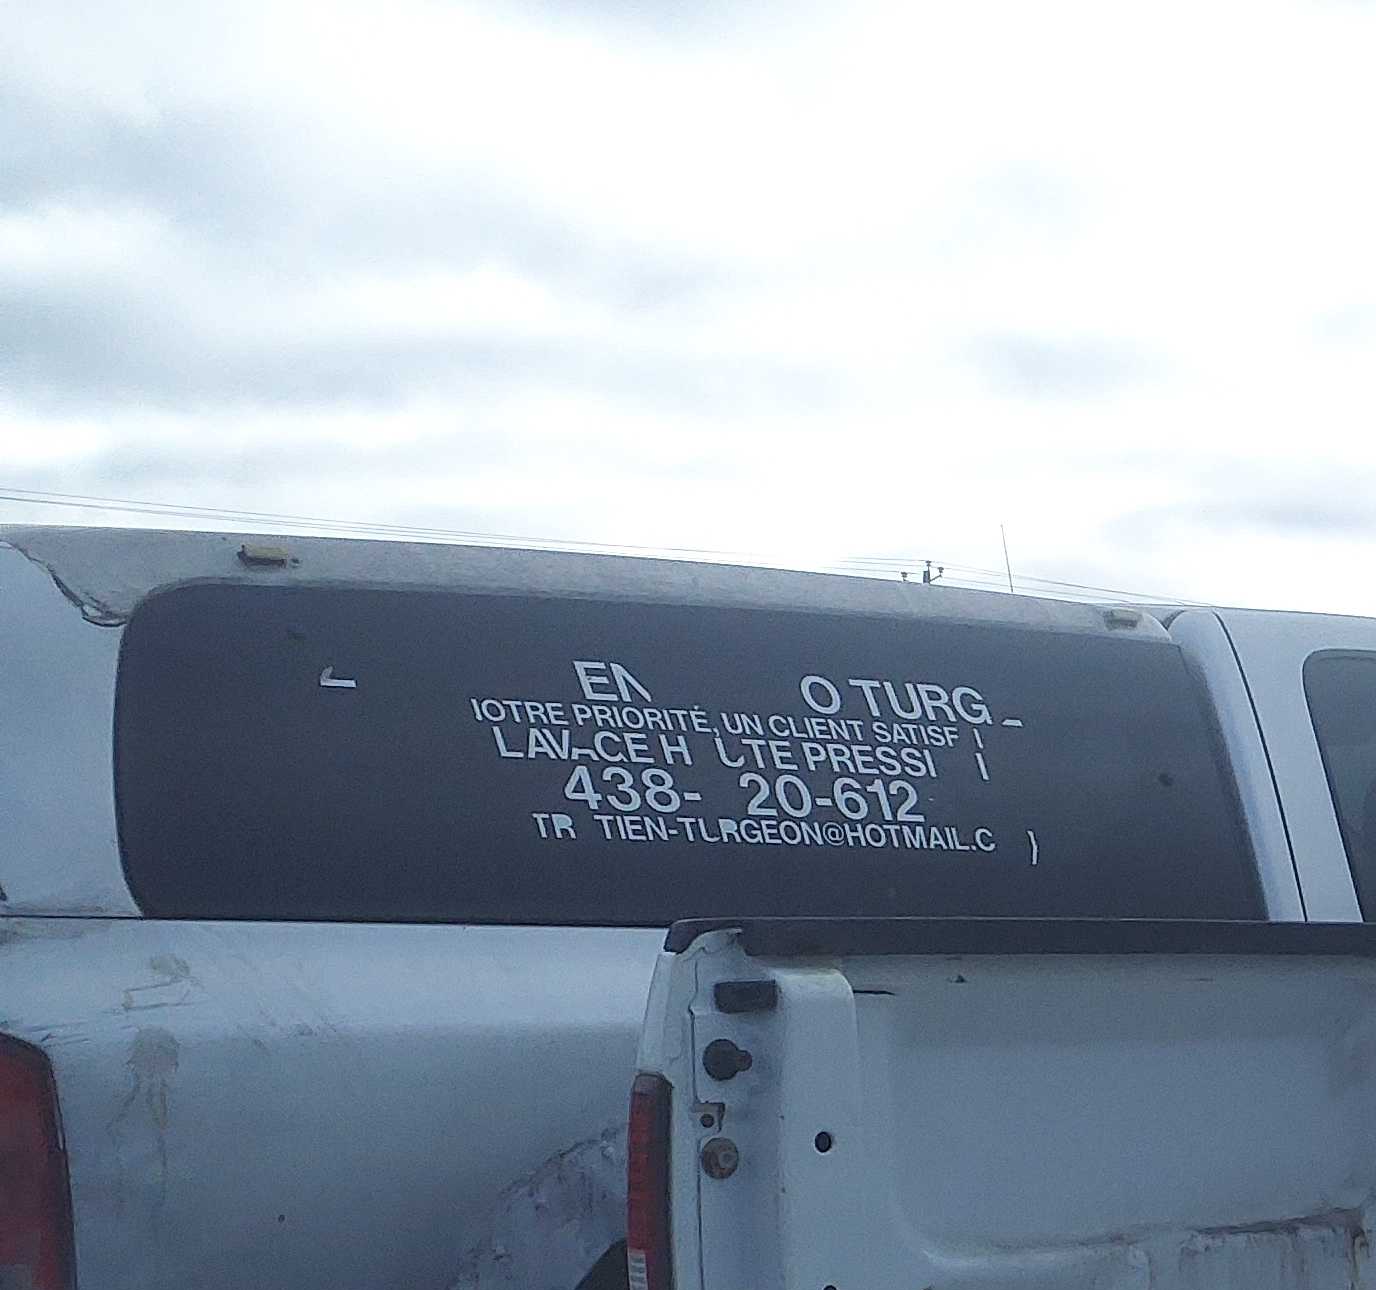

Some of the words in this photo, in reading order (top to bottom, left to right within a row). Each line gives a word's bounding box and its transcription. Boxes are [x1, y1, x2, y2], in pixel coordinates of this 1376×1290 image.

[847, 678, 1024, 727] TURG
[720, 712, 765, 736] UN
[768, 714, 864, 741] CLIENT
